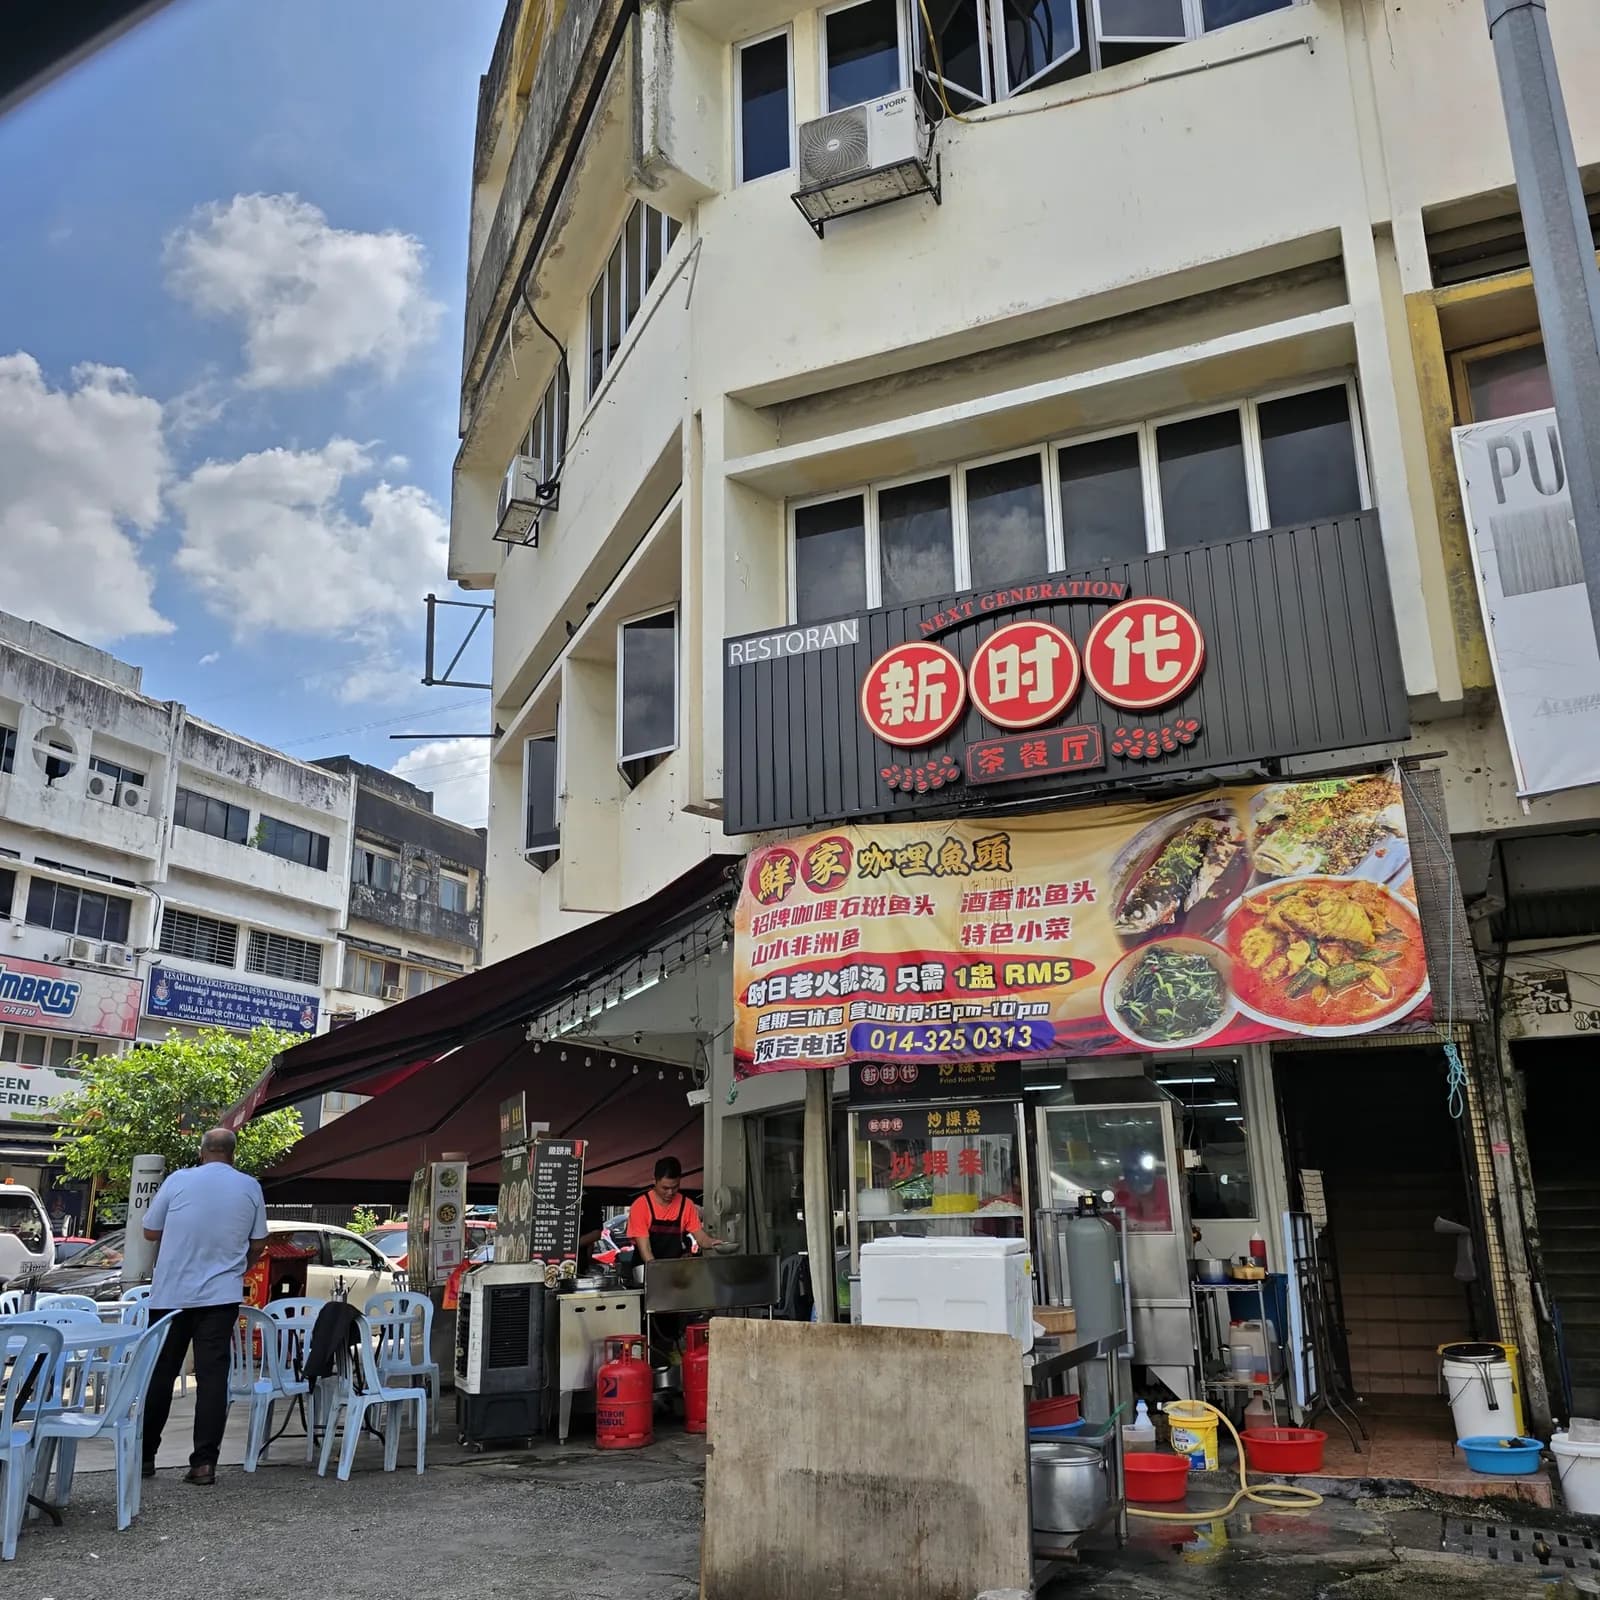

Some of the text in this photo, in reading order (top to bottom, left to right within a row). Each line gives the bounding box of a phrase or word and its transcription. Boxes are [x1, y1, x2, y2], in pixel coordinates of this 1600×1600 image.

[884, 96, 907, 109] YORK
[919, 581, 1124, 635] NEXT GENERATION
[730, 620, 858, 665] RESTORAN
[878, 613, 1182, 727] 新时代
[978, 734, 1089, 775] 茶餐厅
[960, 880, 1097, 914] 酒香松鱼头
[751, 894, 936, 938] 招牌咖哩石斑鱼头
[961, 917, 1071, 946] 特色小菜
[751, 928, 861, 967] 山水非洲鱼
[0, 969, 80, 1016] MBROS
[163, 970, 196, 984] KESATUAN
[896, 963, 945, 992] 只需
[1005, 961, 1072, 987] RM5
[179, 1003, 199, 1014] KUALA
[199, 1007, 223, 1018] LUMPUR
[223, 1010, 235, 1019] CITY
[236, 1011, 250, 1022] HALL
[756, 1007, 844, 1034] 星期三休息
[754, 1029, 848, 1065] 预定电话
[870, 1025, 1032, 1052] 014-325 0313
[137, 1182, 162, 1194] MR
